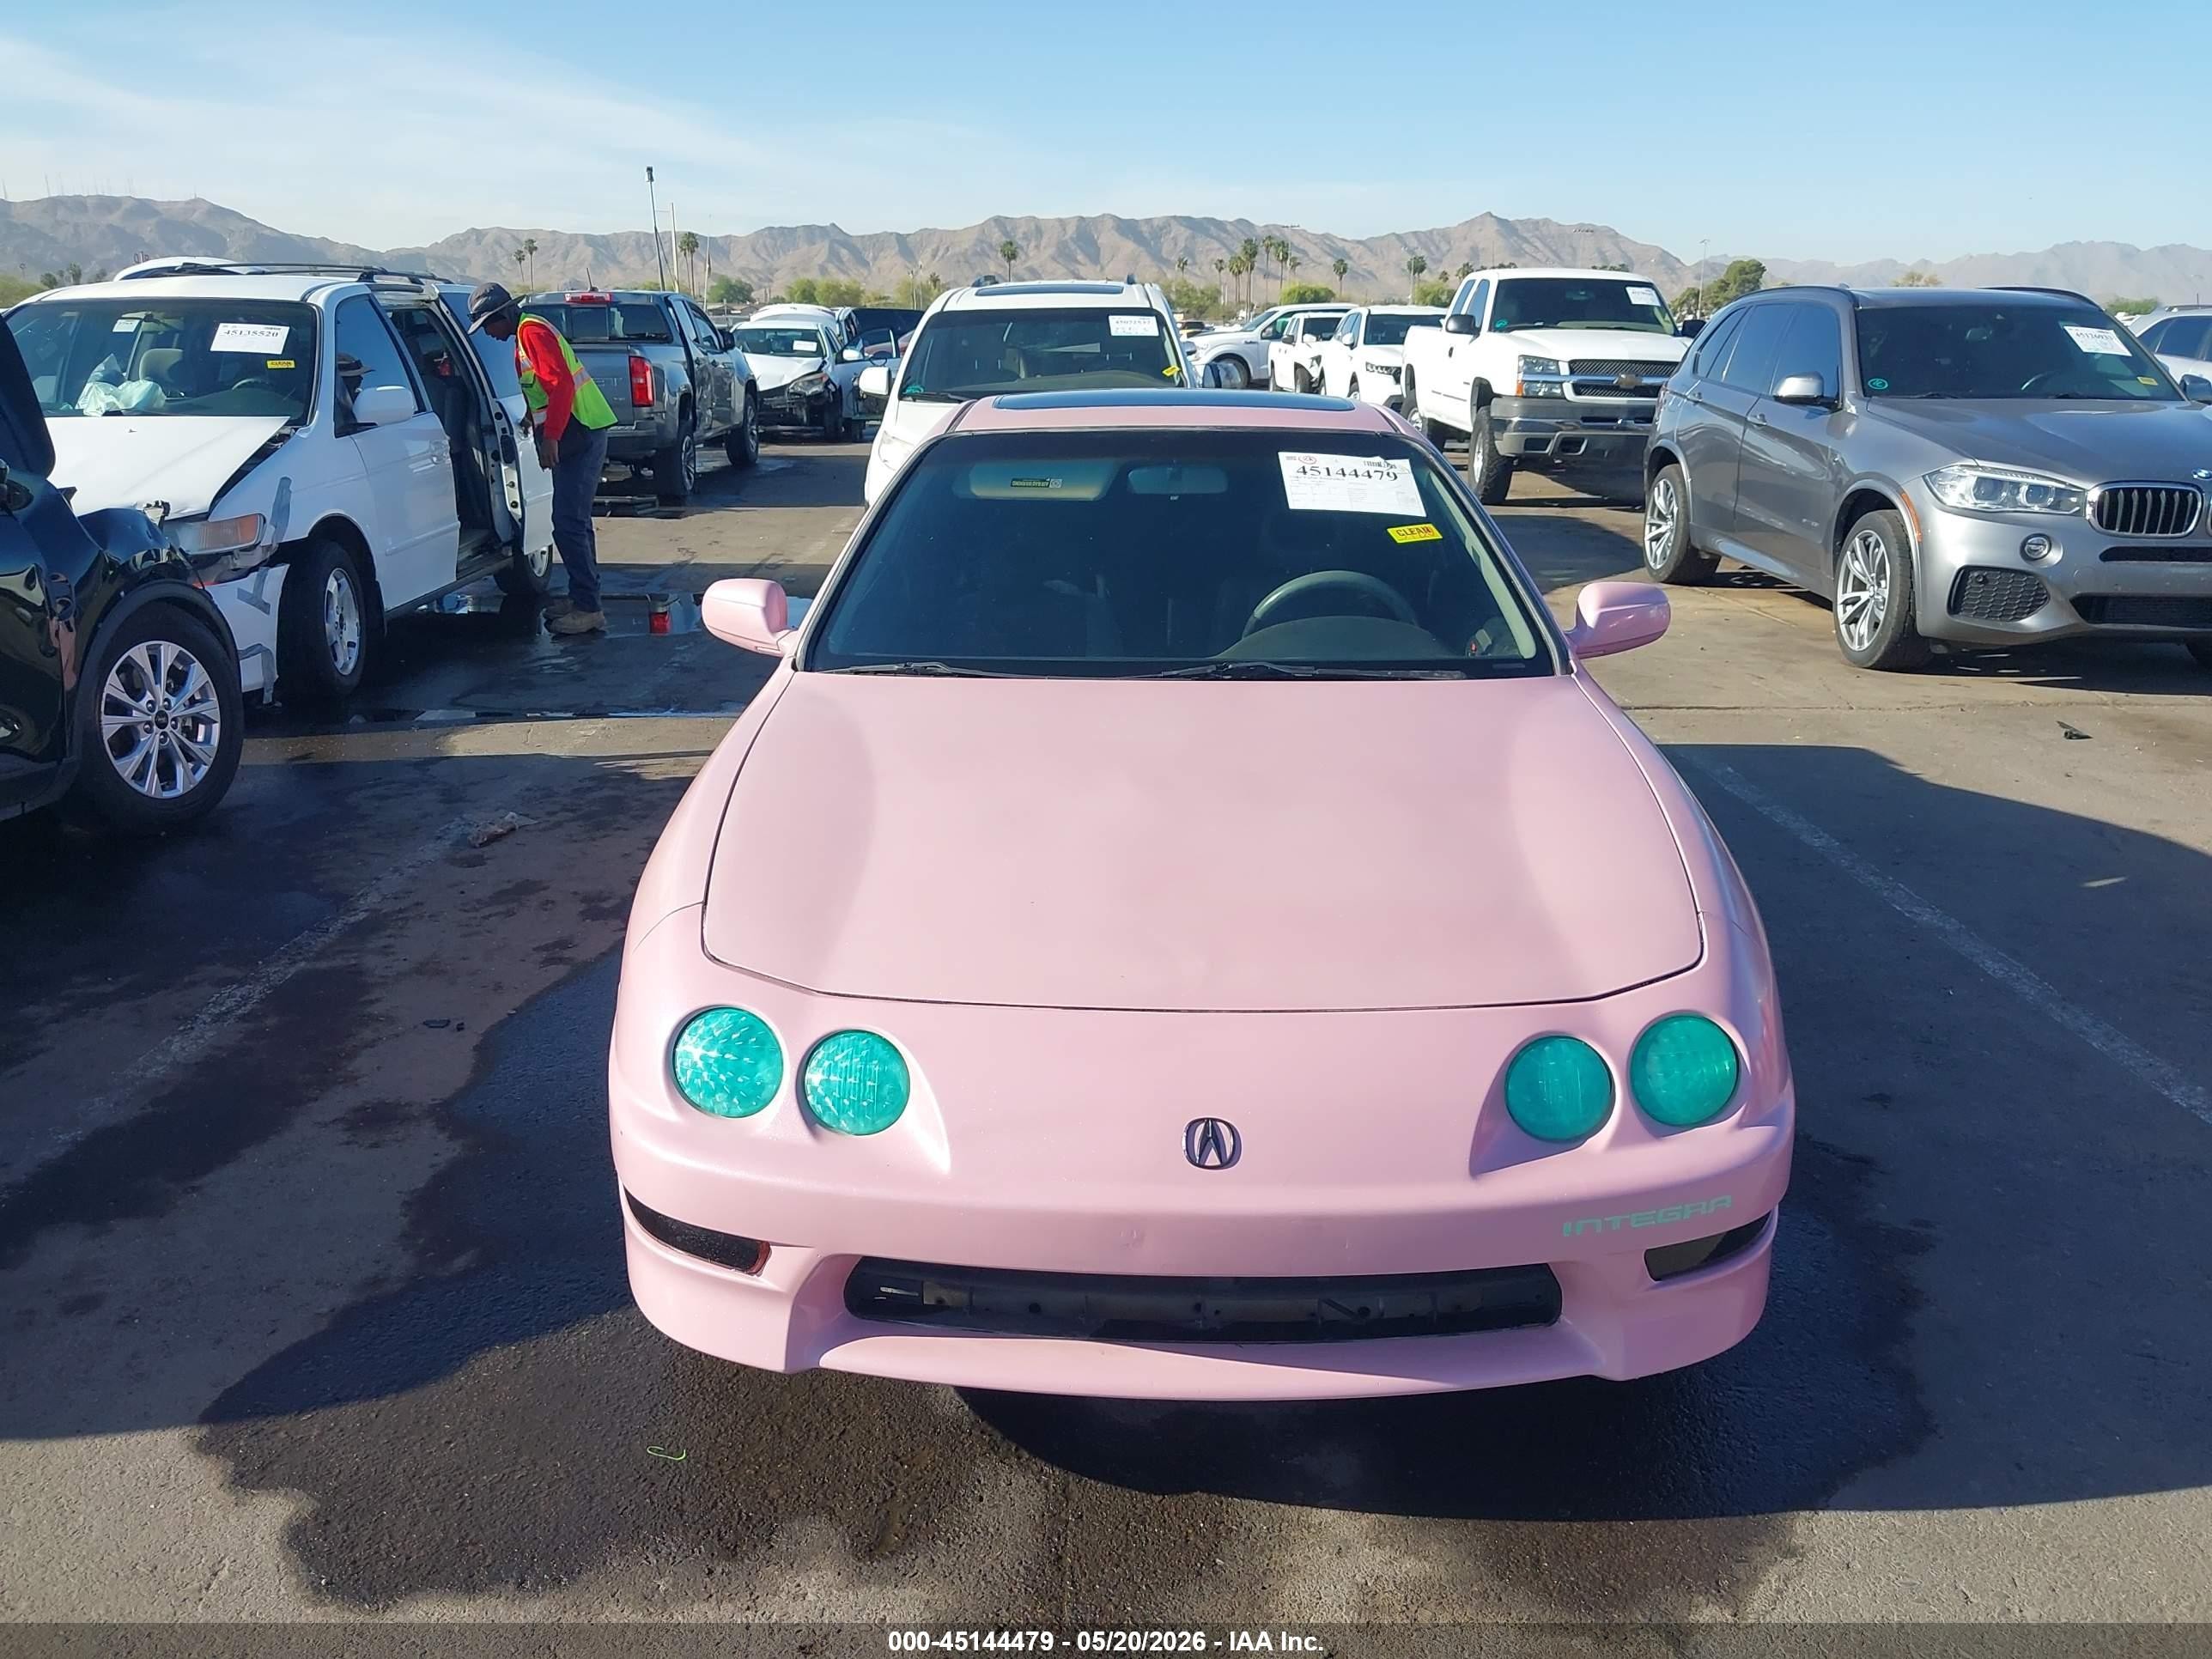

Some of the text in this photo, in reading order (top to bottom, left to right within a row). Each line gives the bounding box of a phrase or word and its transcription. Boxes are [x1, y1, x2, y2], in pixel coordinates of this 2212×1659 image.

[1297, 465, 1398, 482] 45144479
[1395, 526, 1431, 538] CLEAN
[1563, 1195, 1732, 1237] INTEGRA
